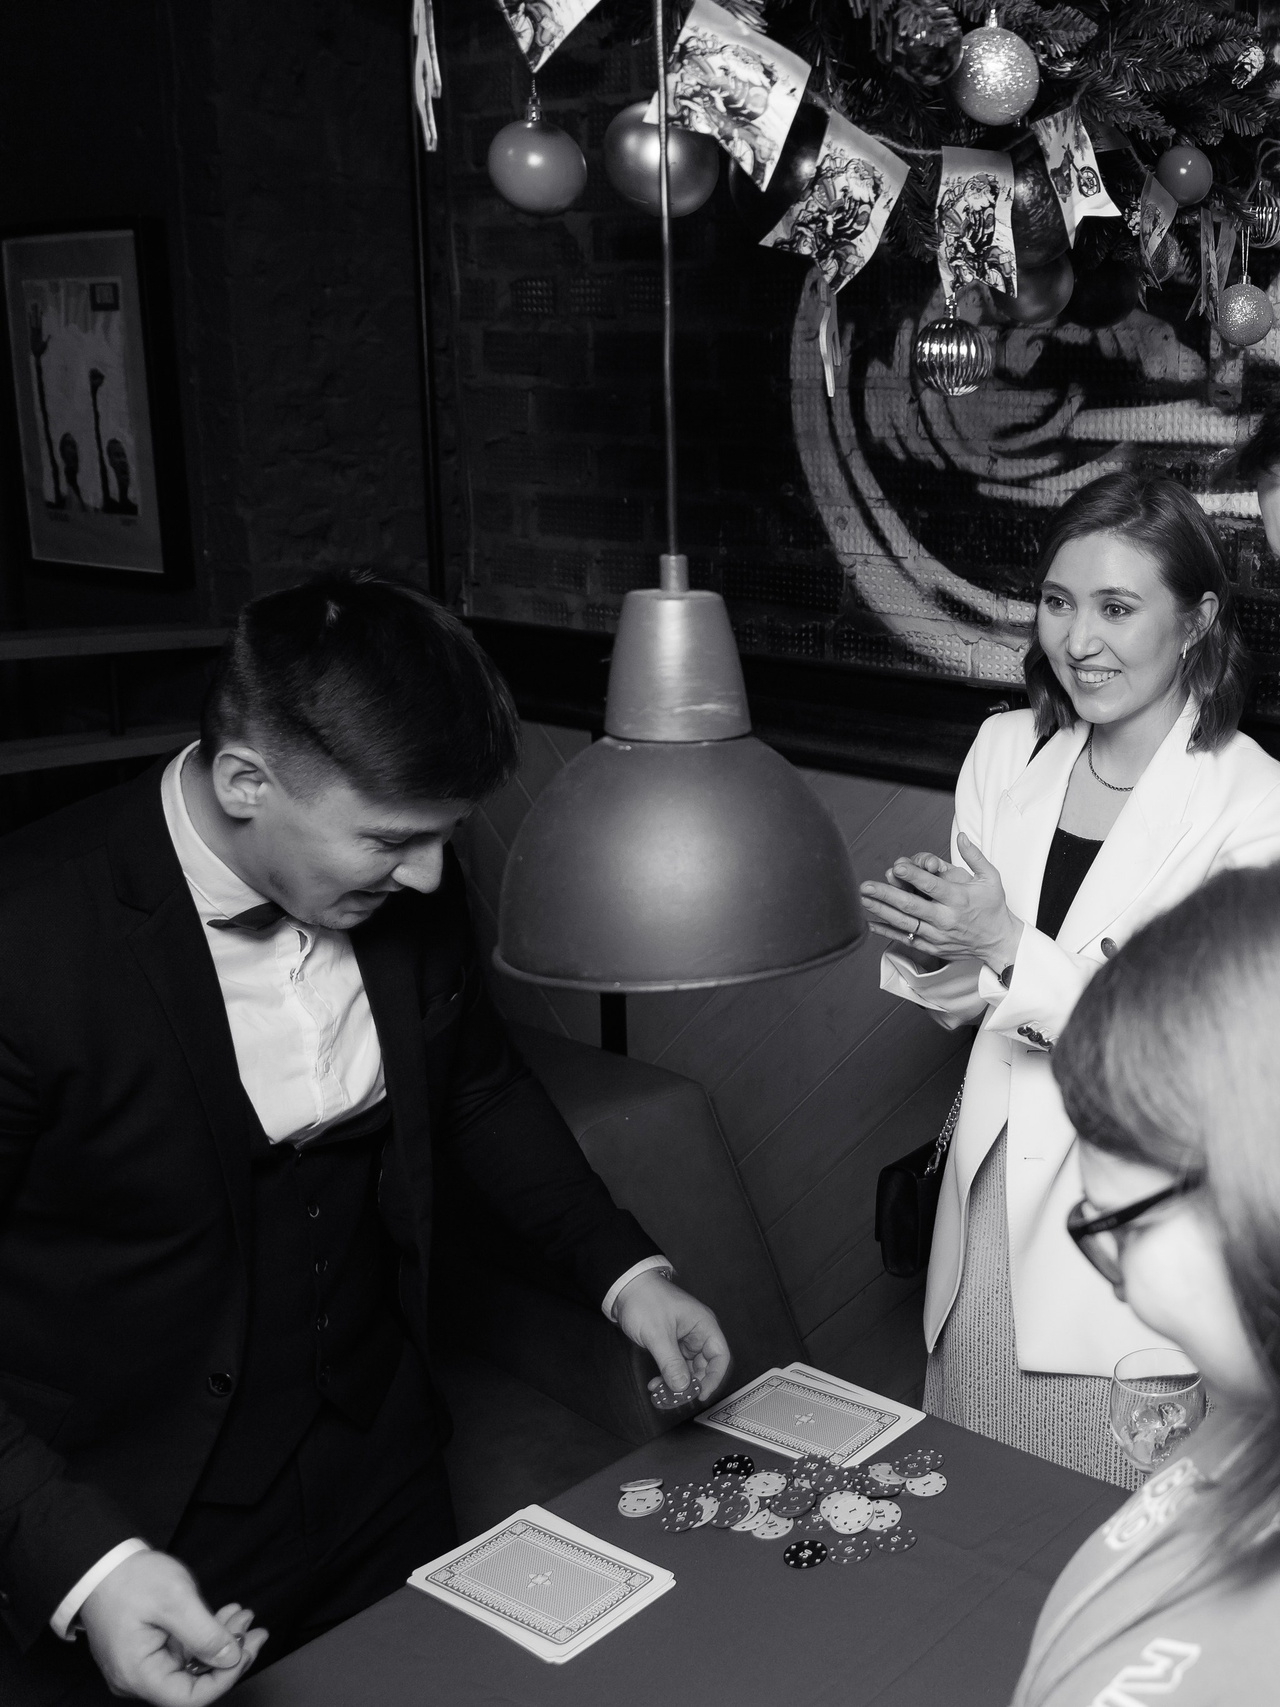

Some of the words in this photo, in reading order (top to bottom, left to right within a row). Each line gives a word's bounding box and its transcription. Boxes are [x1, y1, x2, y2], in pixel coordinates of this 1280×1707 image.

[726, 1461, 739, 1469] 50
[890, 1534, 902, 1543] 10
[799, 1549, 813, 1559] 50
